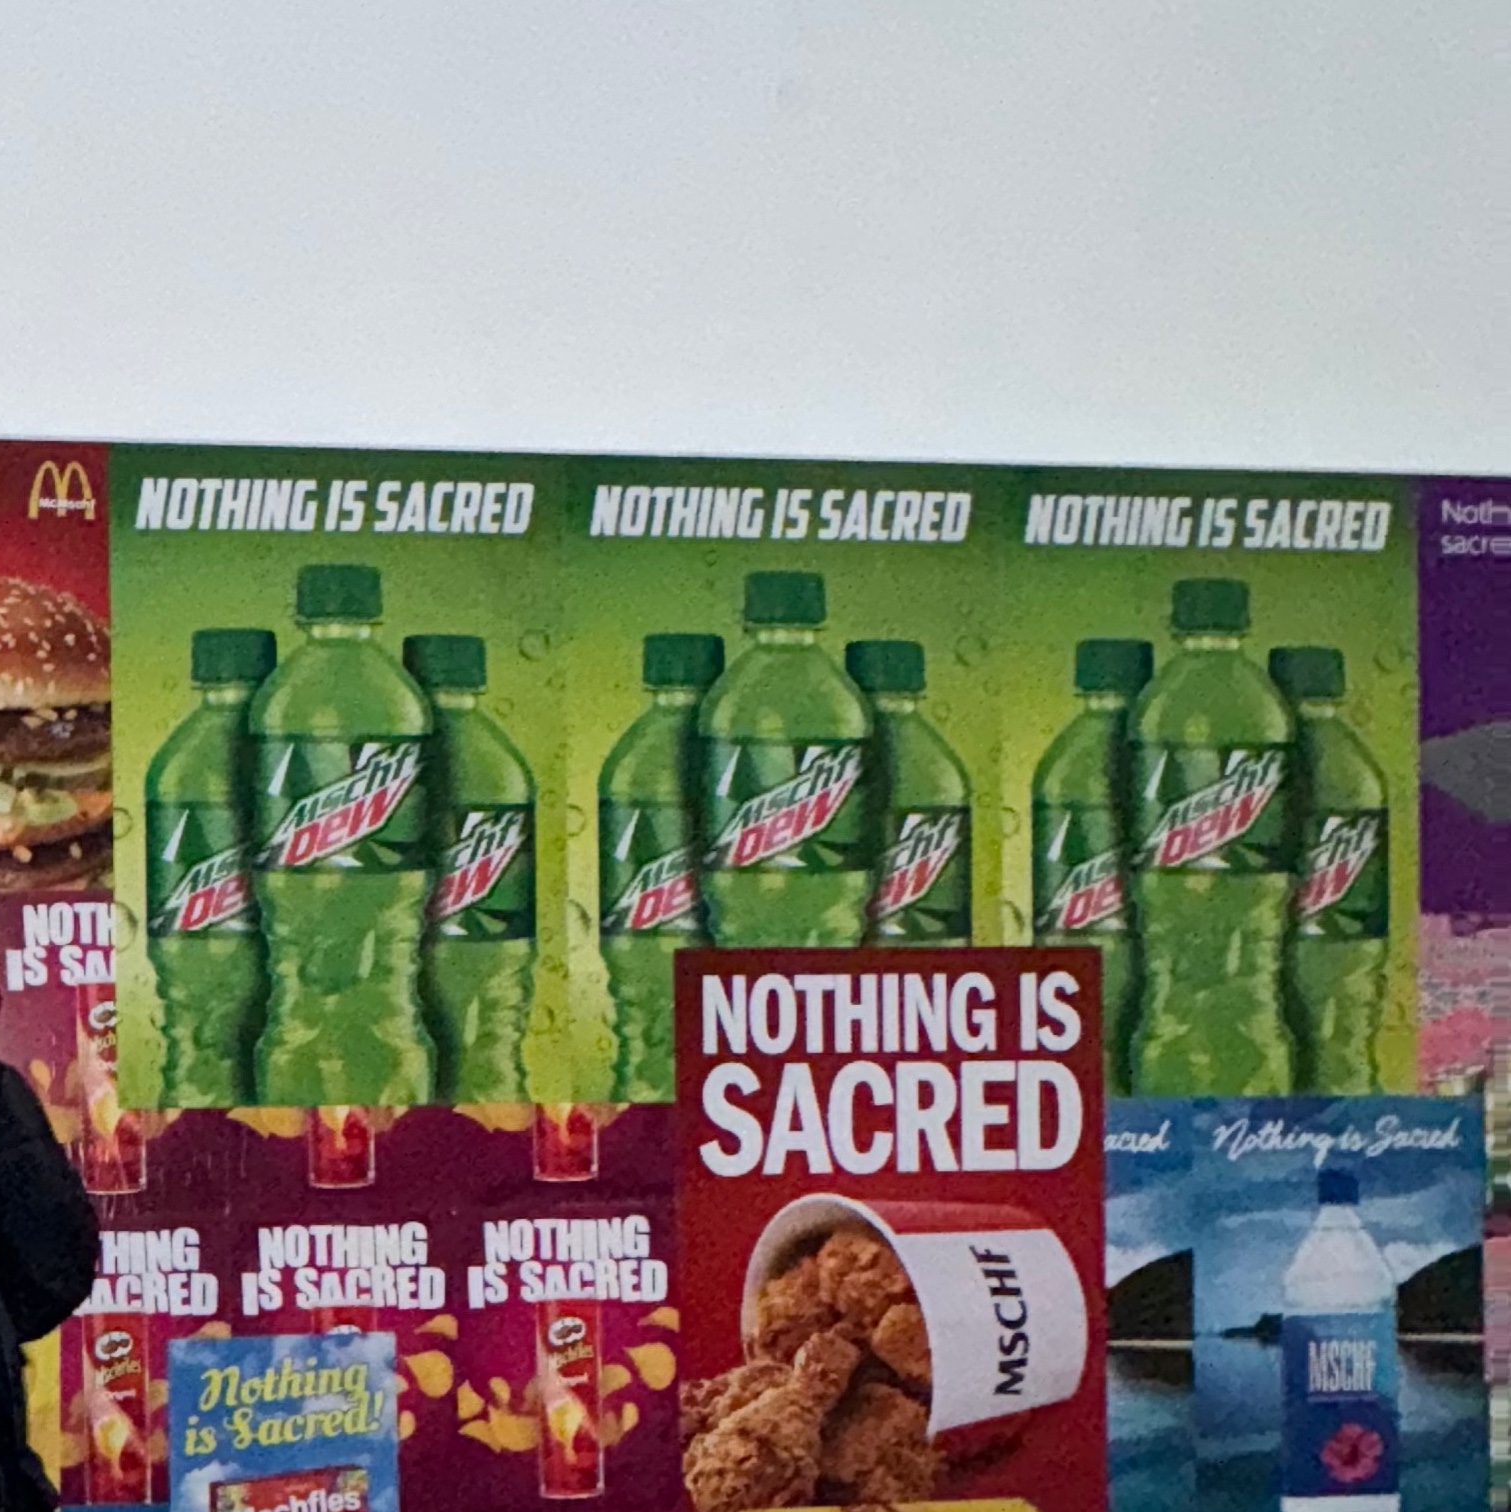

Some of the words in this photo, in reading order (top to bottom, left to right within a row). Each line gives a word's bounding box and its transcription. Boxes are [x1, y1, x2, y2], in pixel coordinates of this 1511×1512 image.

[135, 477, 318, 531] NOTHING
[324, 479, 368, 532] IS
[374, 480, 536, 535] SACRED
[589, 484, 765, 539] NOTHING
[770, 488, 815, 540] IS
[817, 490, 973, 543] SACRED
[1024, 494, 1192, 546] NOTHING
[1196, 497, 1236, 548] IS
[1243, 500, 1391, 552] SACRED
[6, 946, 49, 992] IS
[701, 971, 997, 1056] NOTHING
[1019, 970, 1082, 1052] IS
[698, 1060, 1085, 1178] SACRED
[1213, 1117, 1333, 1168] Nothing
[1339, 1127, 1367, 1152] is
[1366, 1114, 1461, 1158] Sacred
[257, 1220, 429, 1269] NOTHING
[483, 1215, 651, 1262] NOTHING
[241, 1268, 284, 1316] IS
[295, 1266, 447, 1310] SACRED
[466, 1261, 510, 1310] IS
[519, 1258, 669, 1303] SACRED
[969, 1244, 1030, 1396] MSCHF
[198, 1357, 369, 1412] Nothing
[1307, 1338, 1378, 1394] MSCHF
[183, 1415, 218, 1457] is
[222, 1389, 385, 1450] Sacred!
